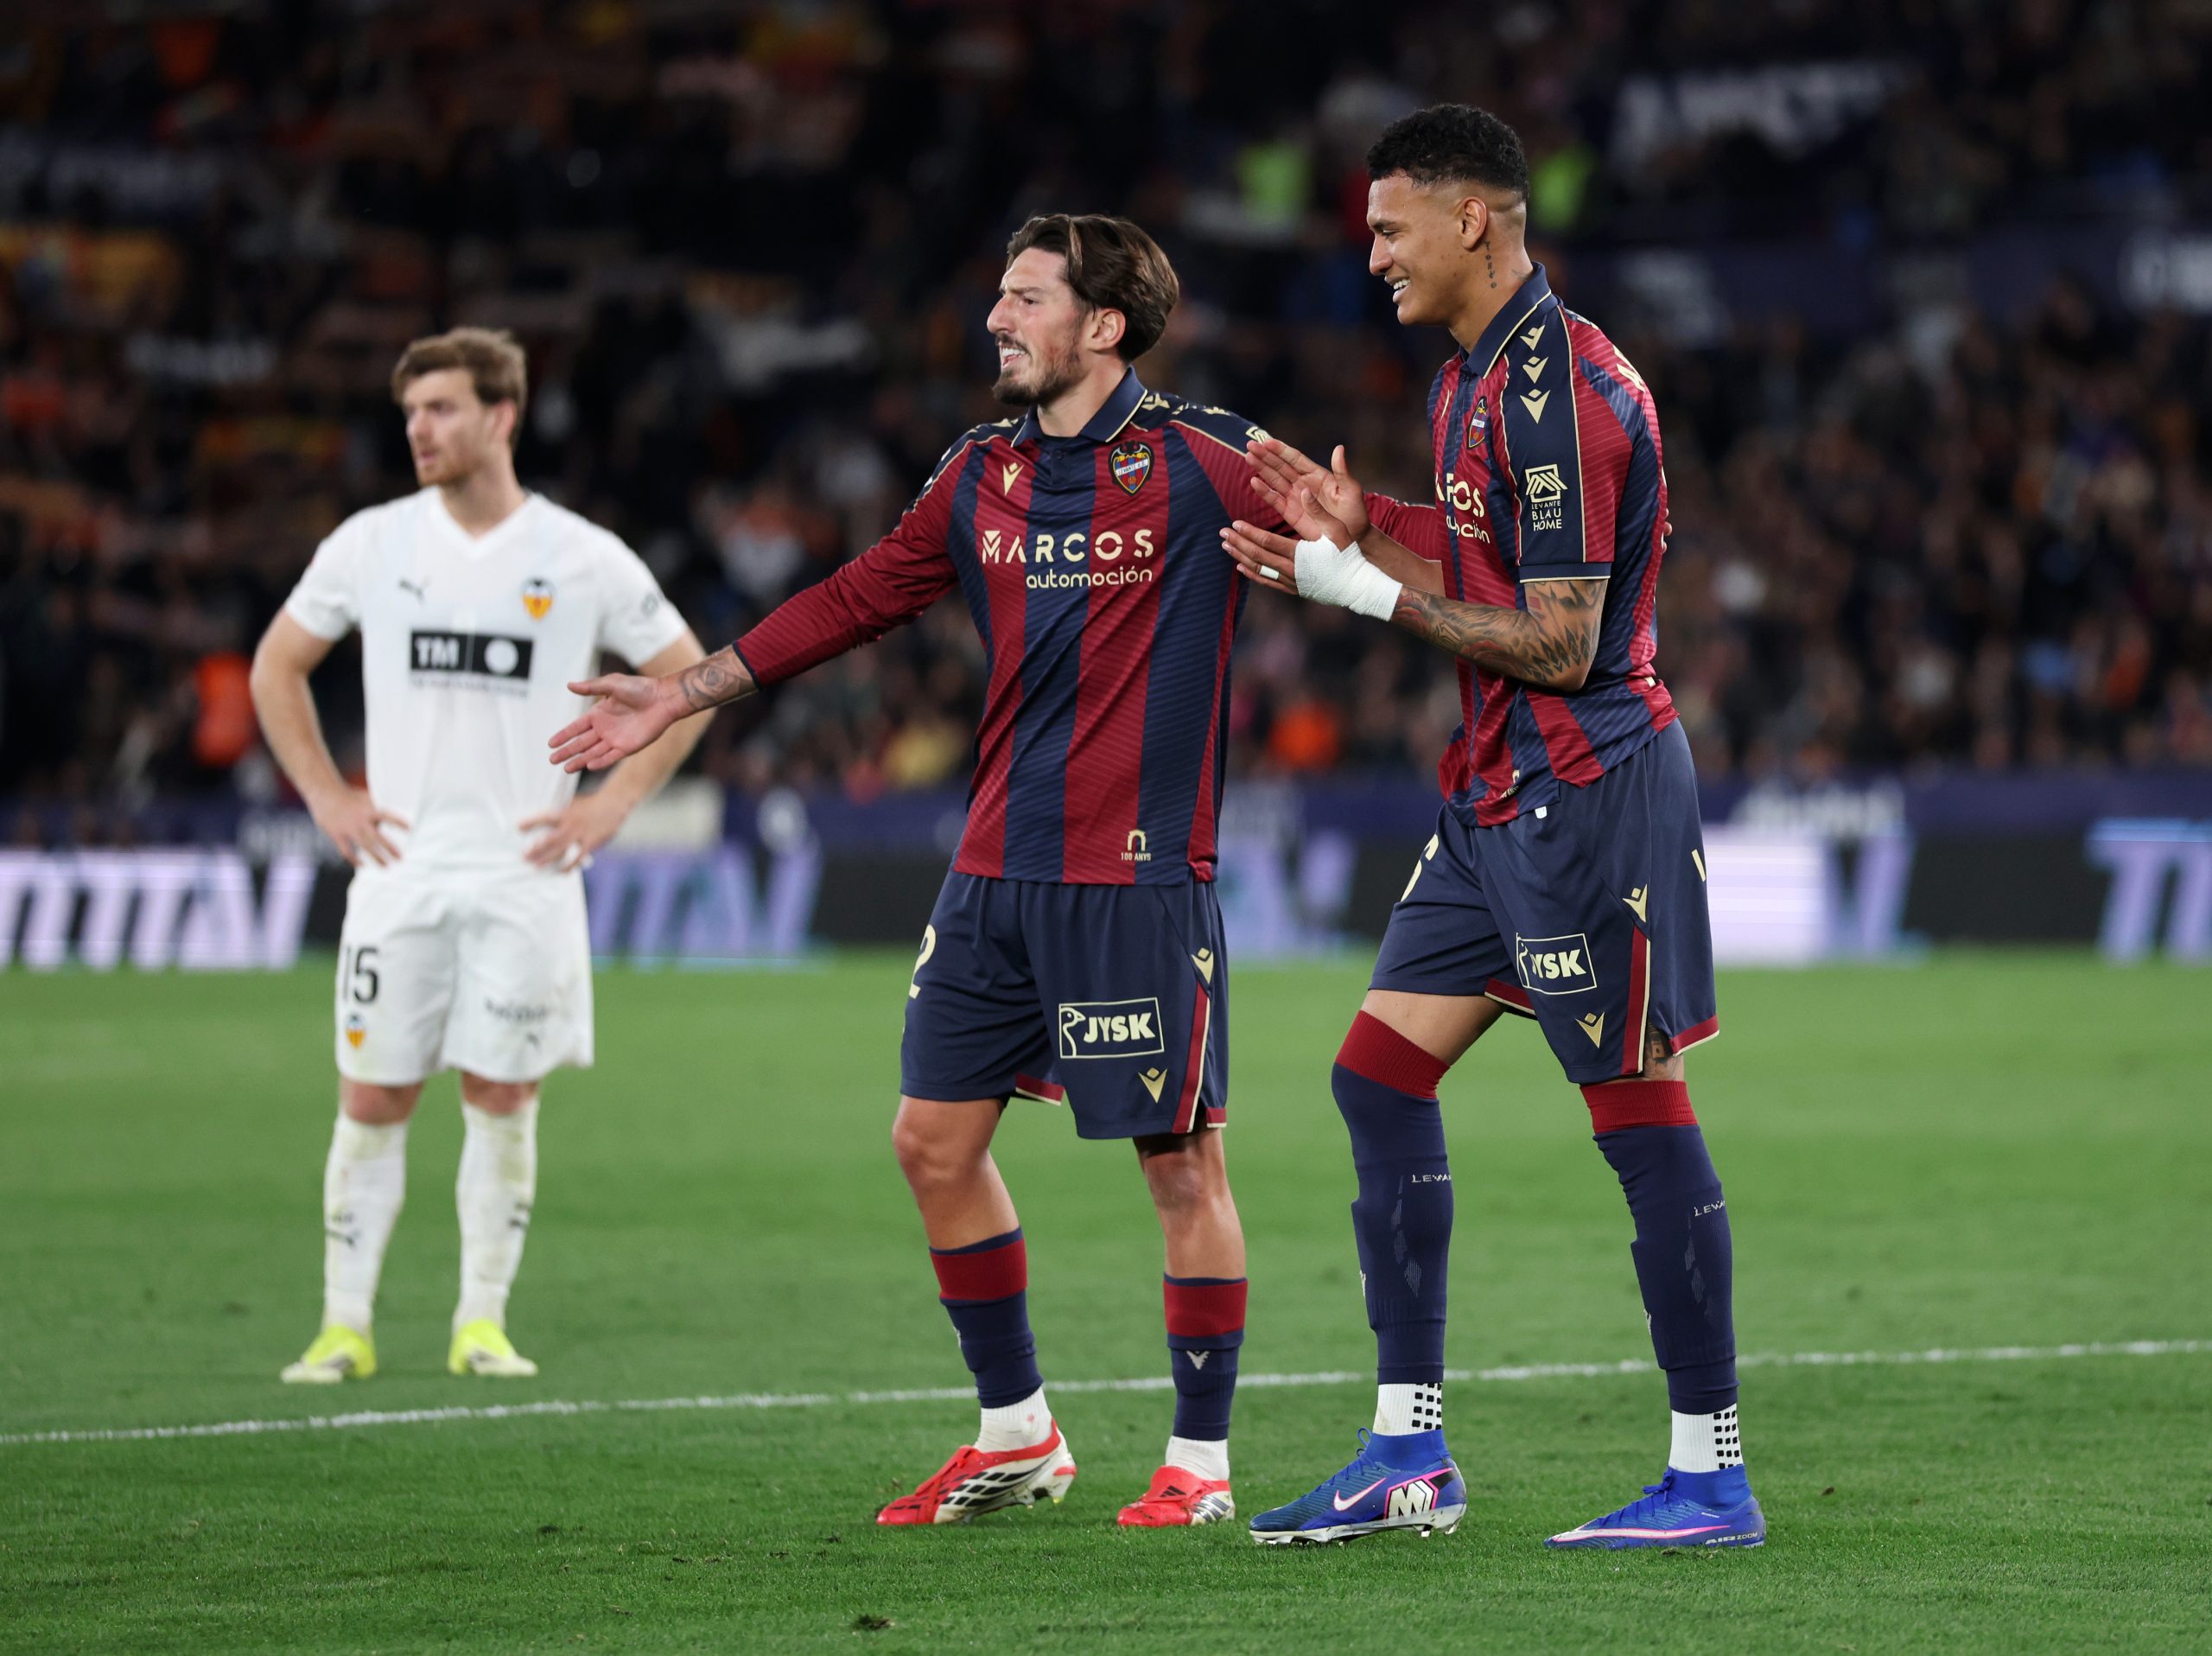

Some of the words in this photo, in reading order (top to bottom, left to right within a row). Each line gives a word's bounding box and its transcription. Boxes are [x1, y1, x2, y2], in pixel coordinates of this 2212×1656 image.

[1532, 500, 1561, 510] LEVANTE
[1532, 508, 1561, 520] BLAU
[1534, 519, 1562, 532] HOME
[982, 529, 1154, 564] MARCOS
[1026, 565, 1154, 589] automoción
[414, 636, 460, 668] TM
[1121, 851, 1133, 861] 100
[1134, 852, 1152, 862] ANYS
[1529, 948, 1587, 979] YSK
[343, 946, 379, 1004] 15
[1083, 1012, 1156, 1043] JYSK
[1694, 1200, 1726, 1217] LEVA
[1737, 1532, 1758, 1541] ZOOM
